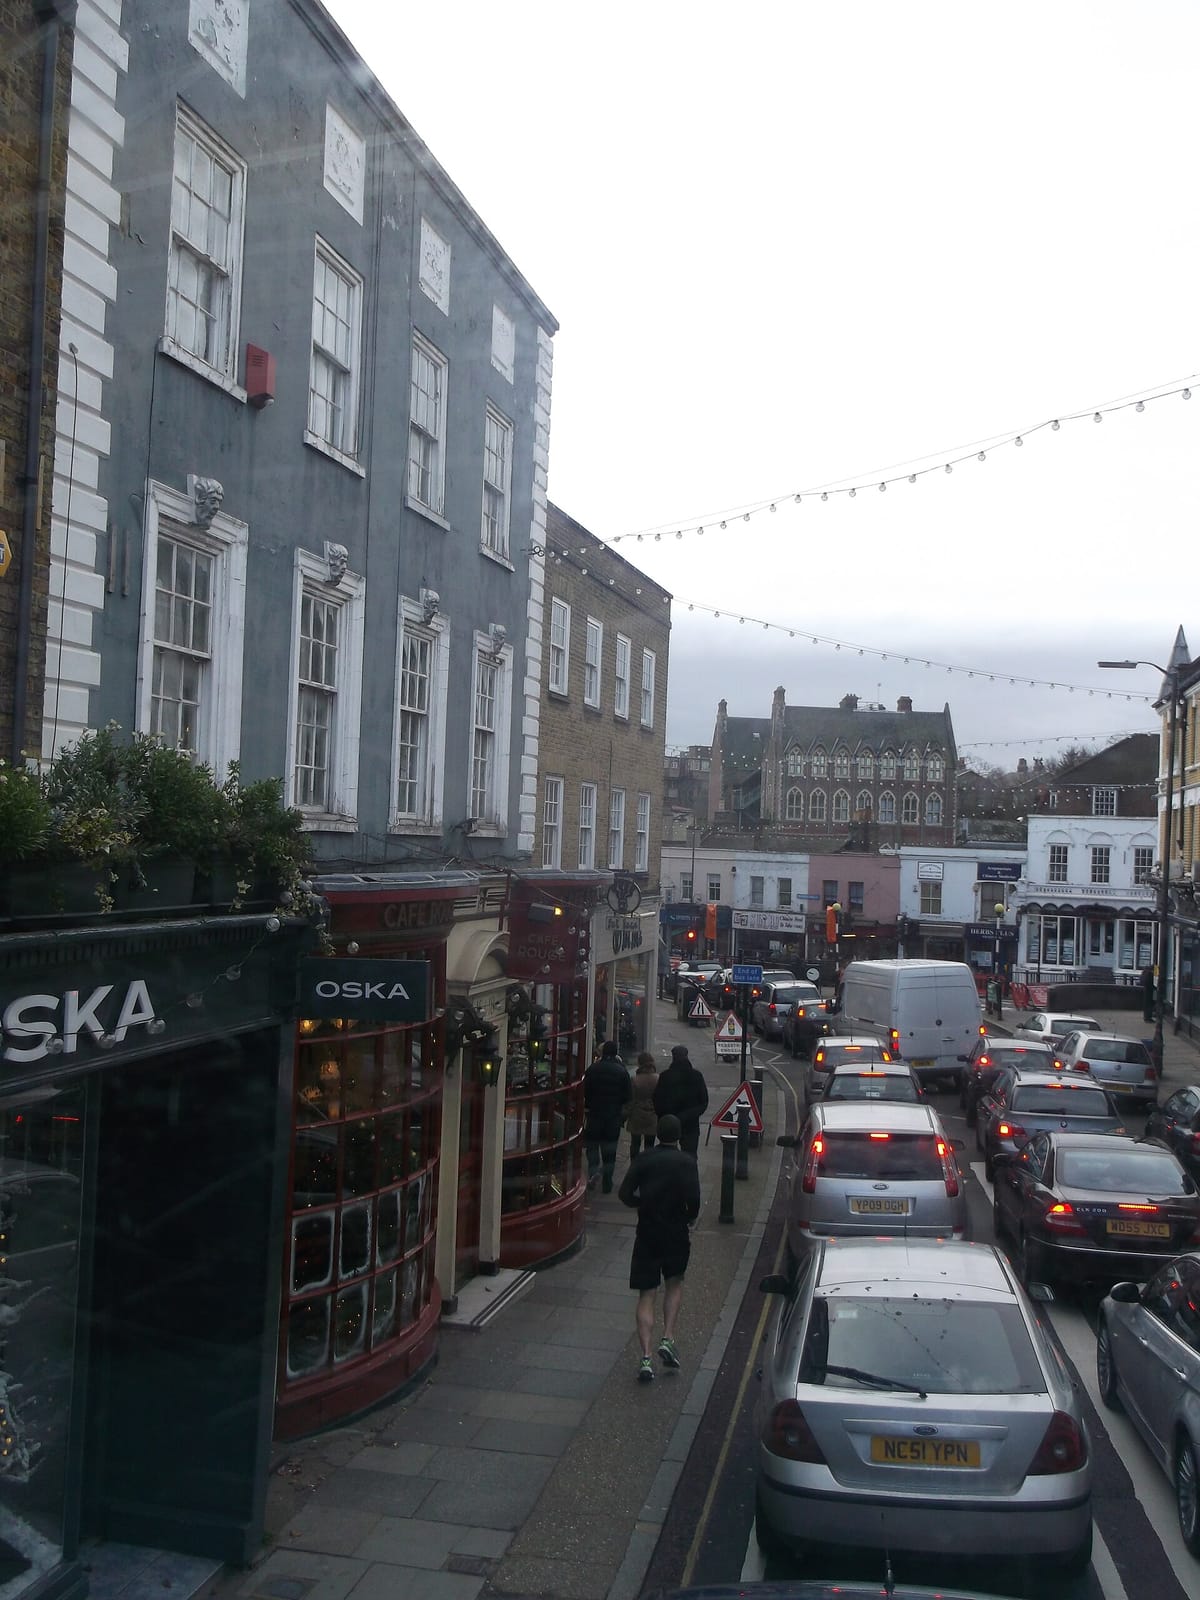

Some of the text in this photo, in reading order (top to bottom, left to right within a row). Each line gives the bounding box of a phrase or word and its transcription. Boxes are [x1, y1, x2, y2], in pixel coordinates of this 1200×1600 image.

[315, 980, 410, 1000] OSKA
[0, 979, 155, 1063] SKA
[884, 1439, 968, 1463] NC51 YPN
